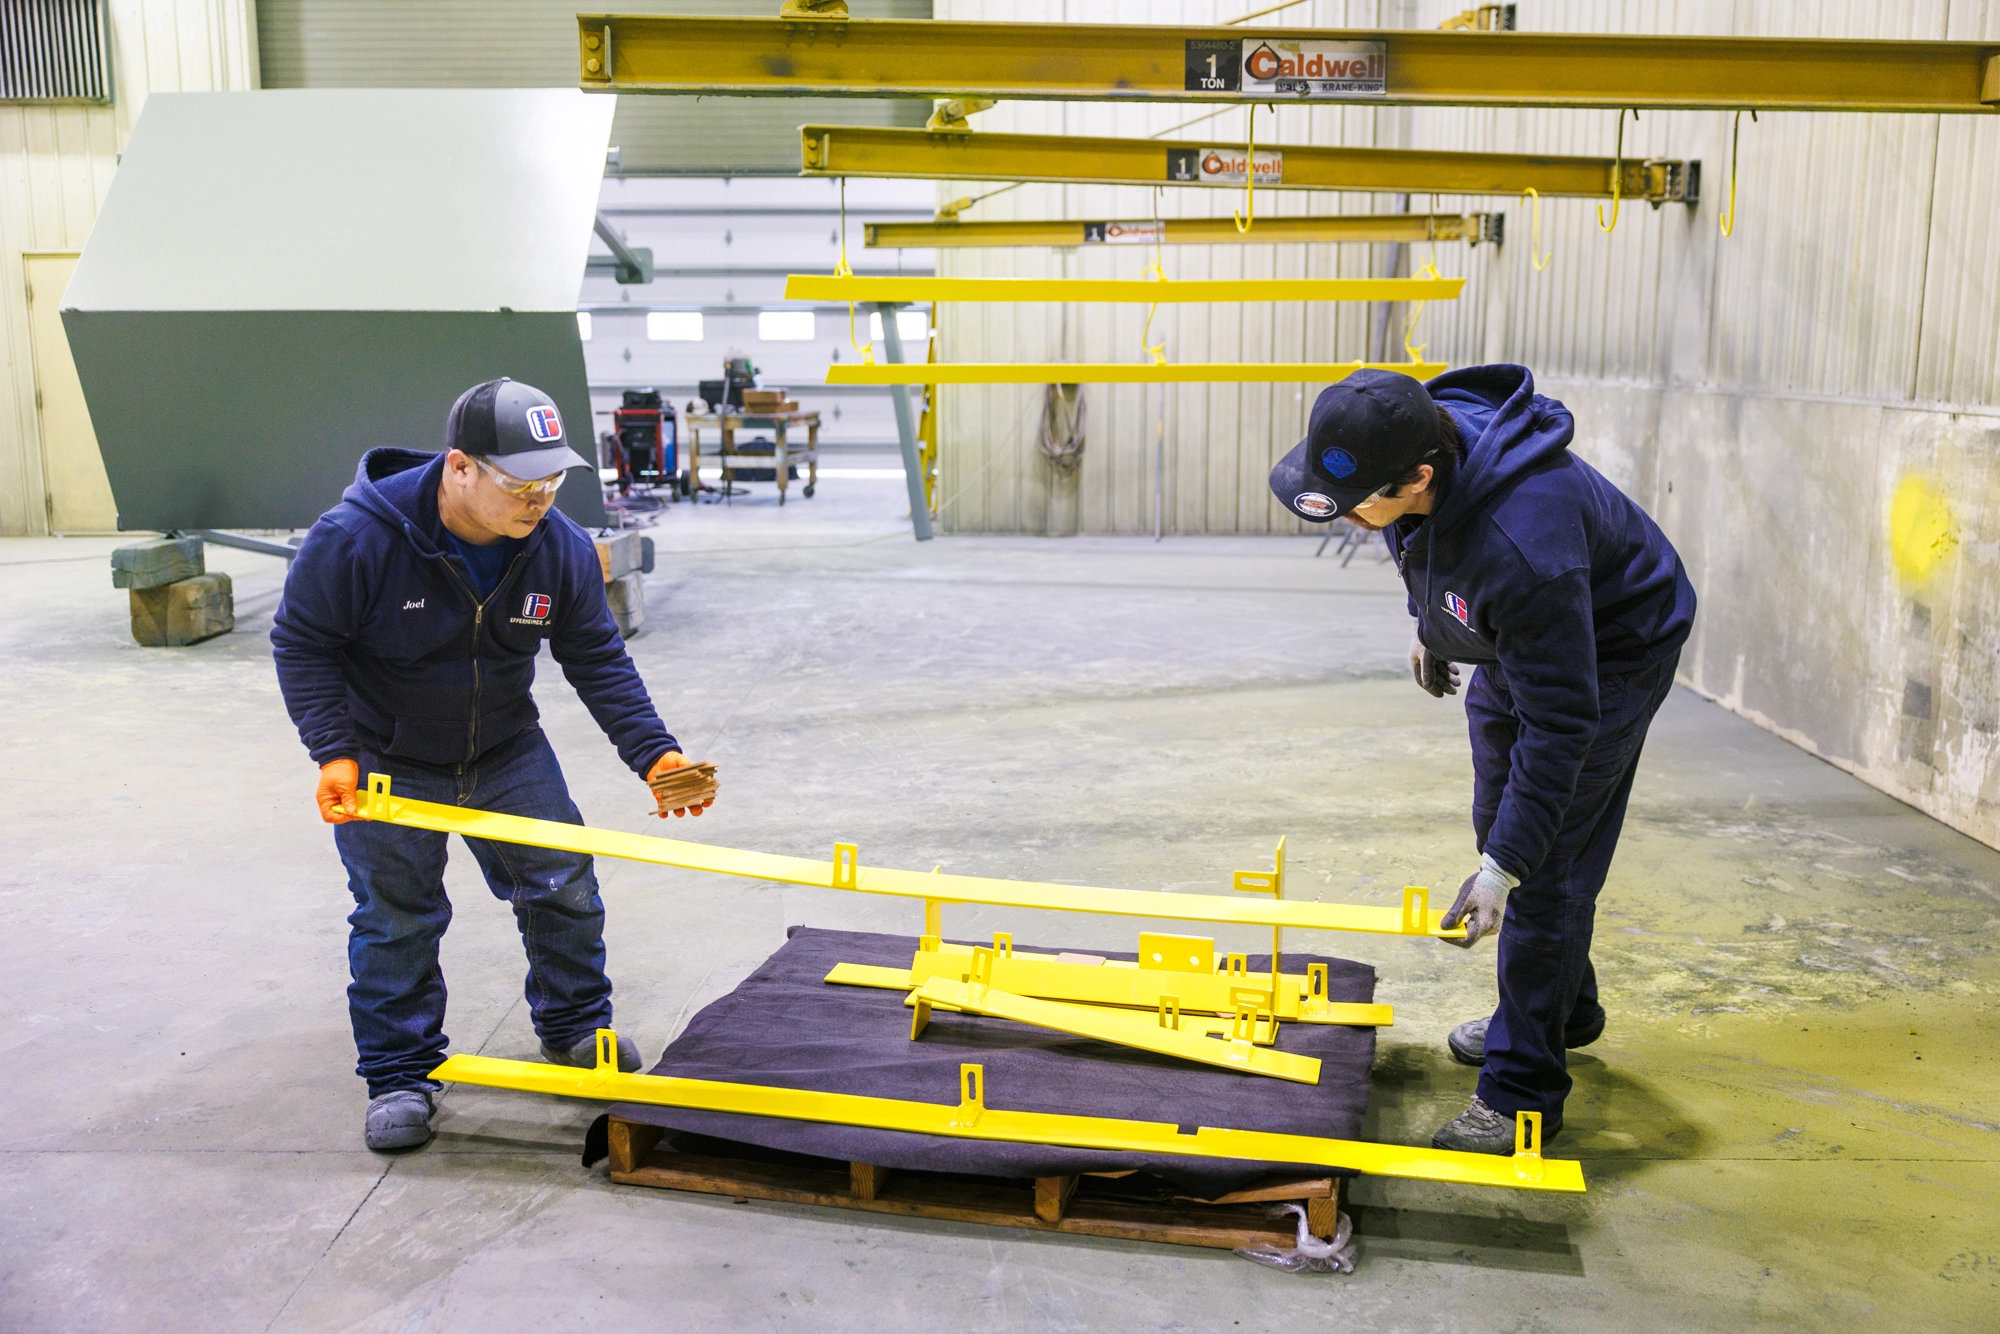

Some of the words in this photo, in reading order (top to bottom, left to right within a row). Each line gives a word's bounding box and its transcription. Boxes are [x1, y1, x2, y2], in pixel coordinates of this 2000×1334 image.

[1206, 54, 1217, 78] 1
[1249, 50, 1385, 79] Caldwell
[1200, 78, 1225, 89] TON
[1179, 157, 1186, 173] 1
[1203, 155, 1281, 174] Caldwell
[402, 598, 425, 610] Joel
